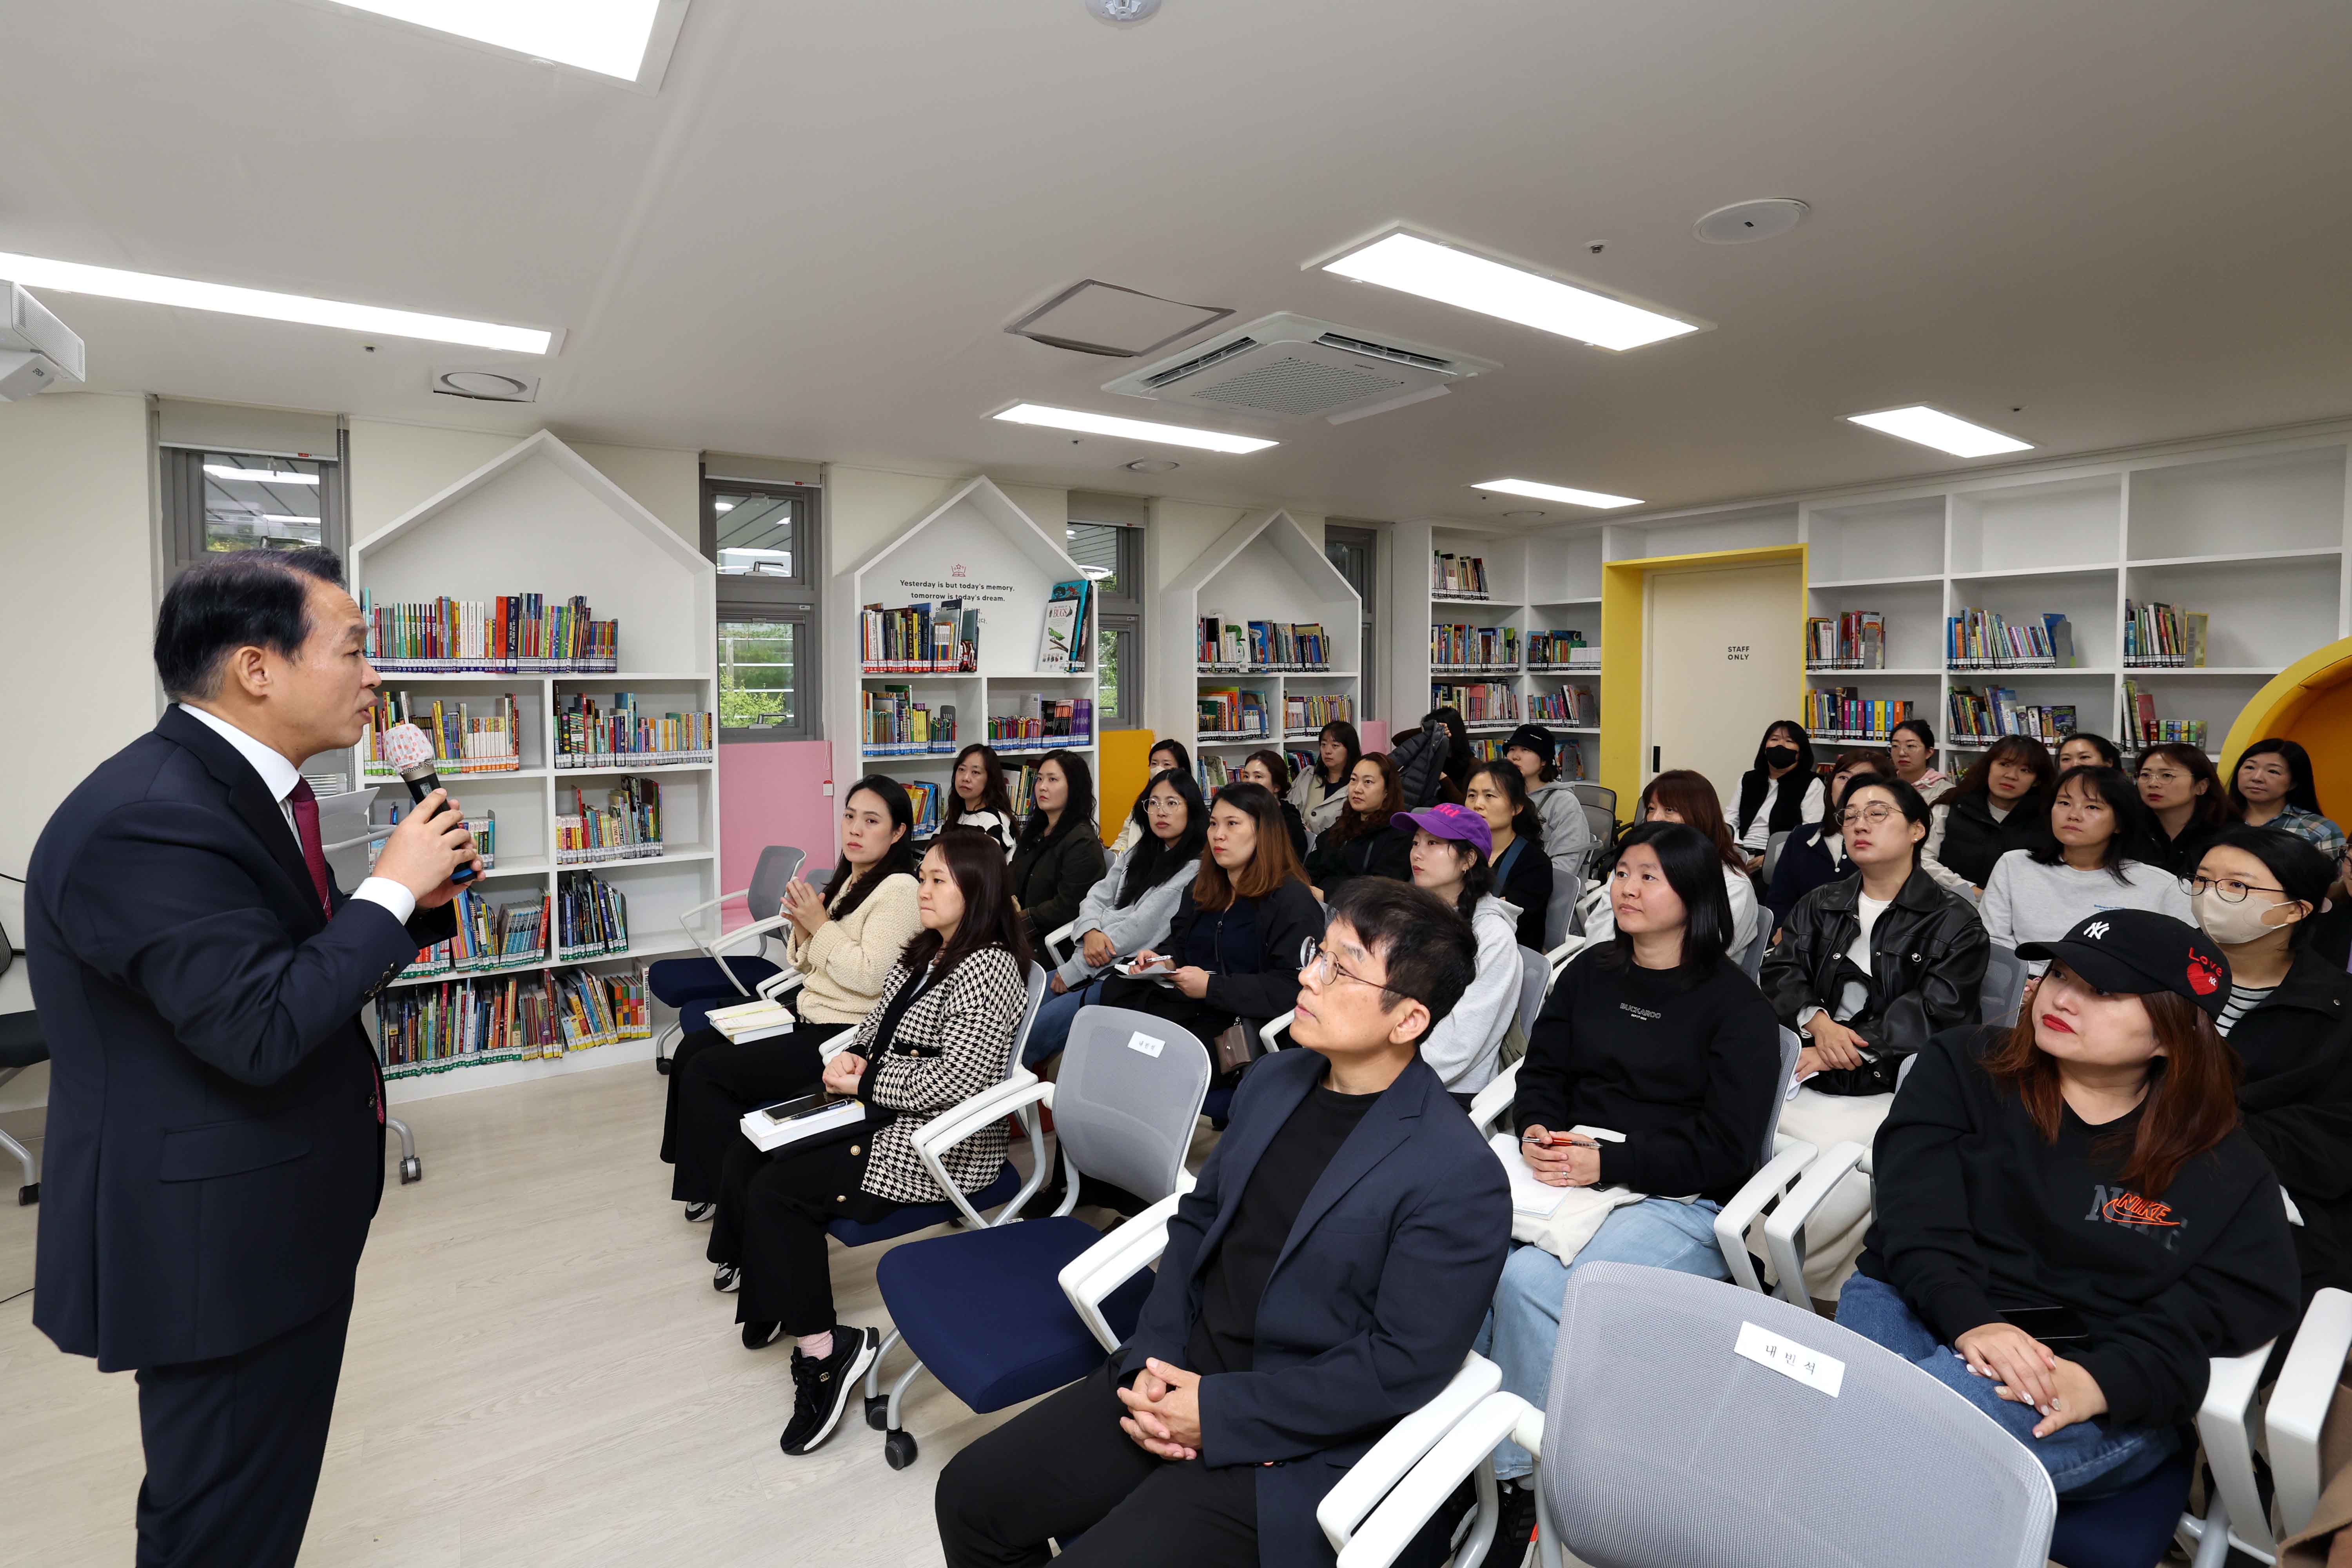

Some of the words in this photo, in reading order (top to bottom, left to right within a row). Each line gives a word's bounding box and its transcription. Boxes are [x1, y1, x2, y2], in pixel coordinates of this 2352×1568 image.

[1053, 608, 1067, 617] BUGS
[2189, 947, 2223, 977] Love
[2117, 1193, 2172, 1222] NIKE
